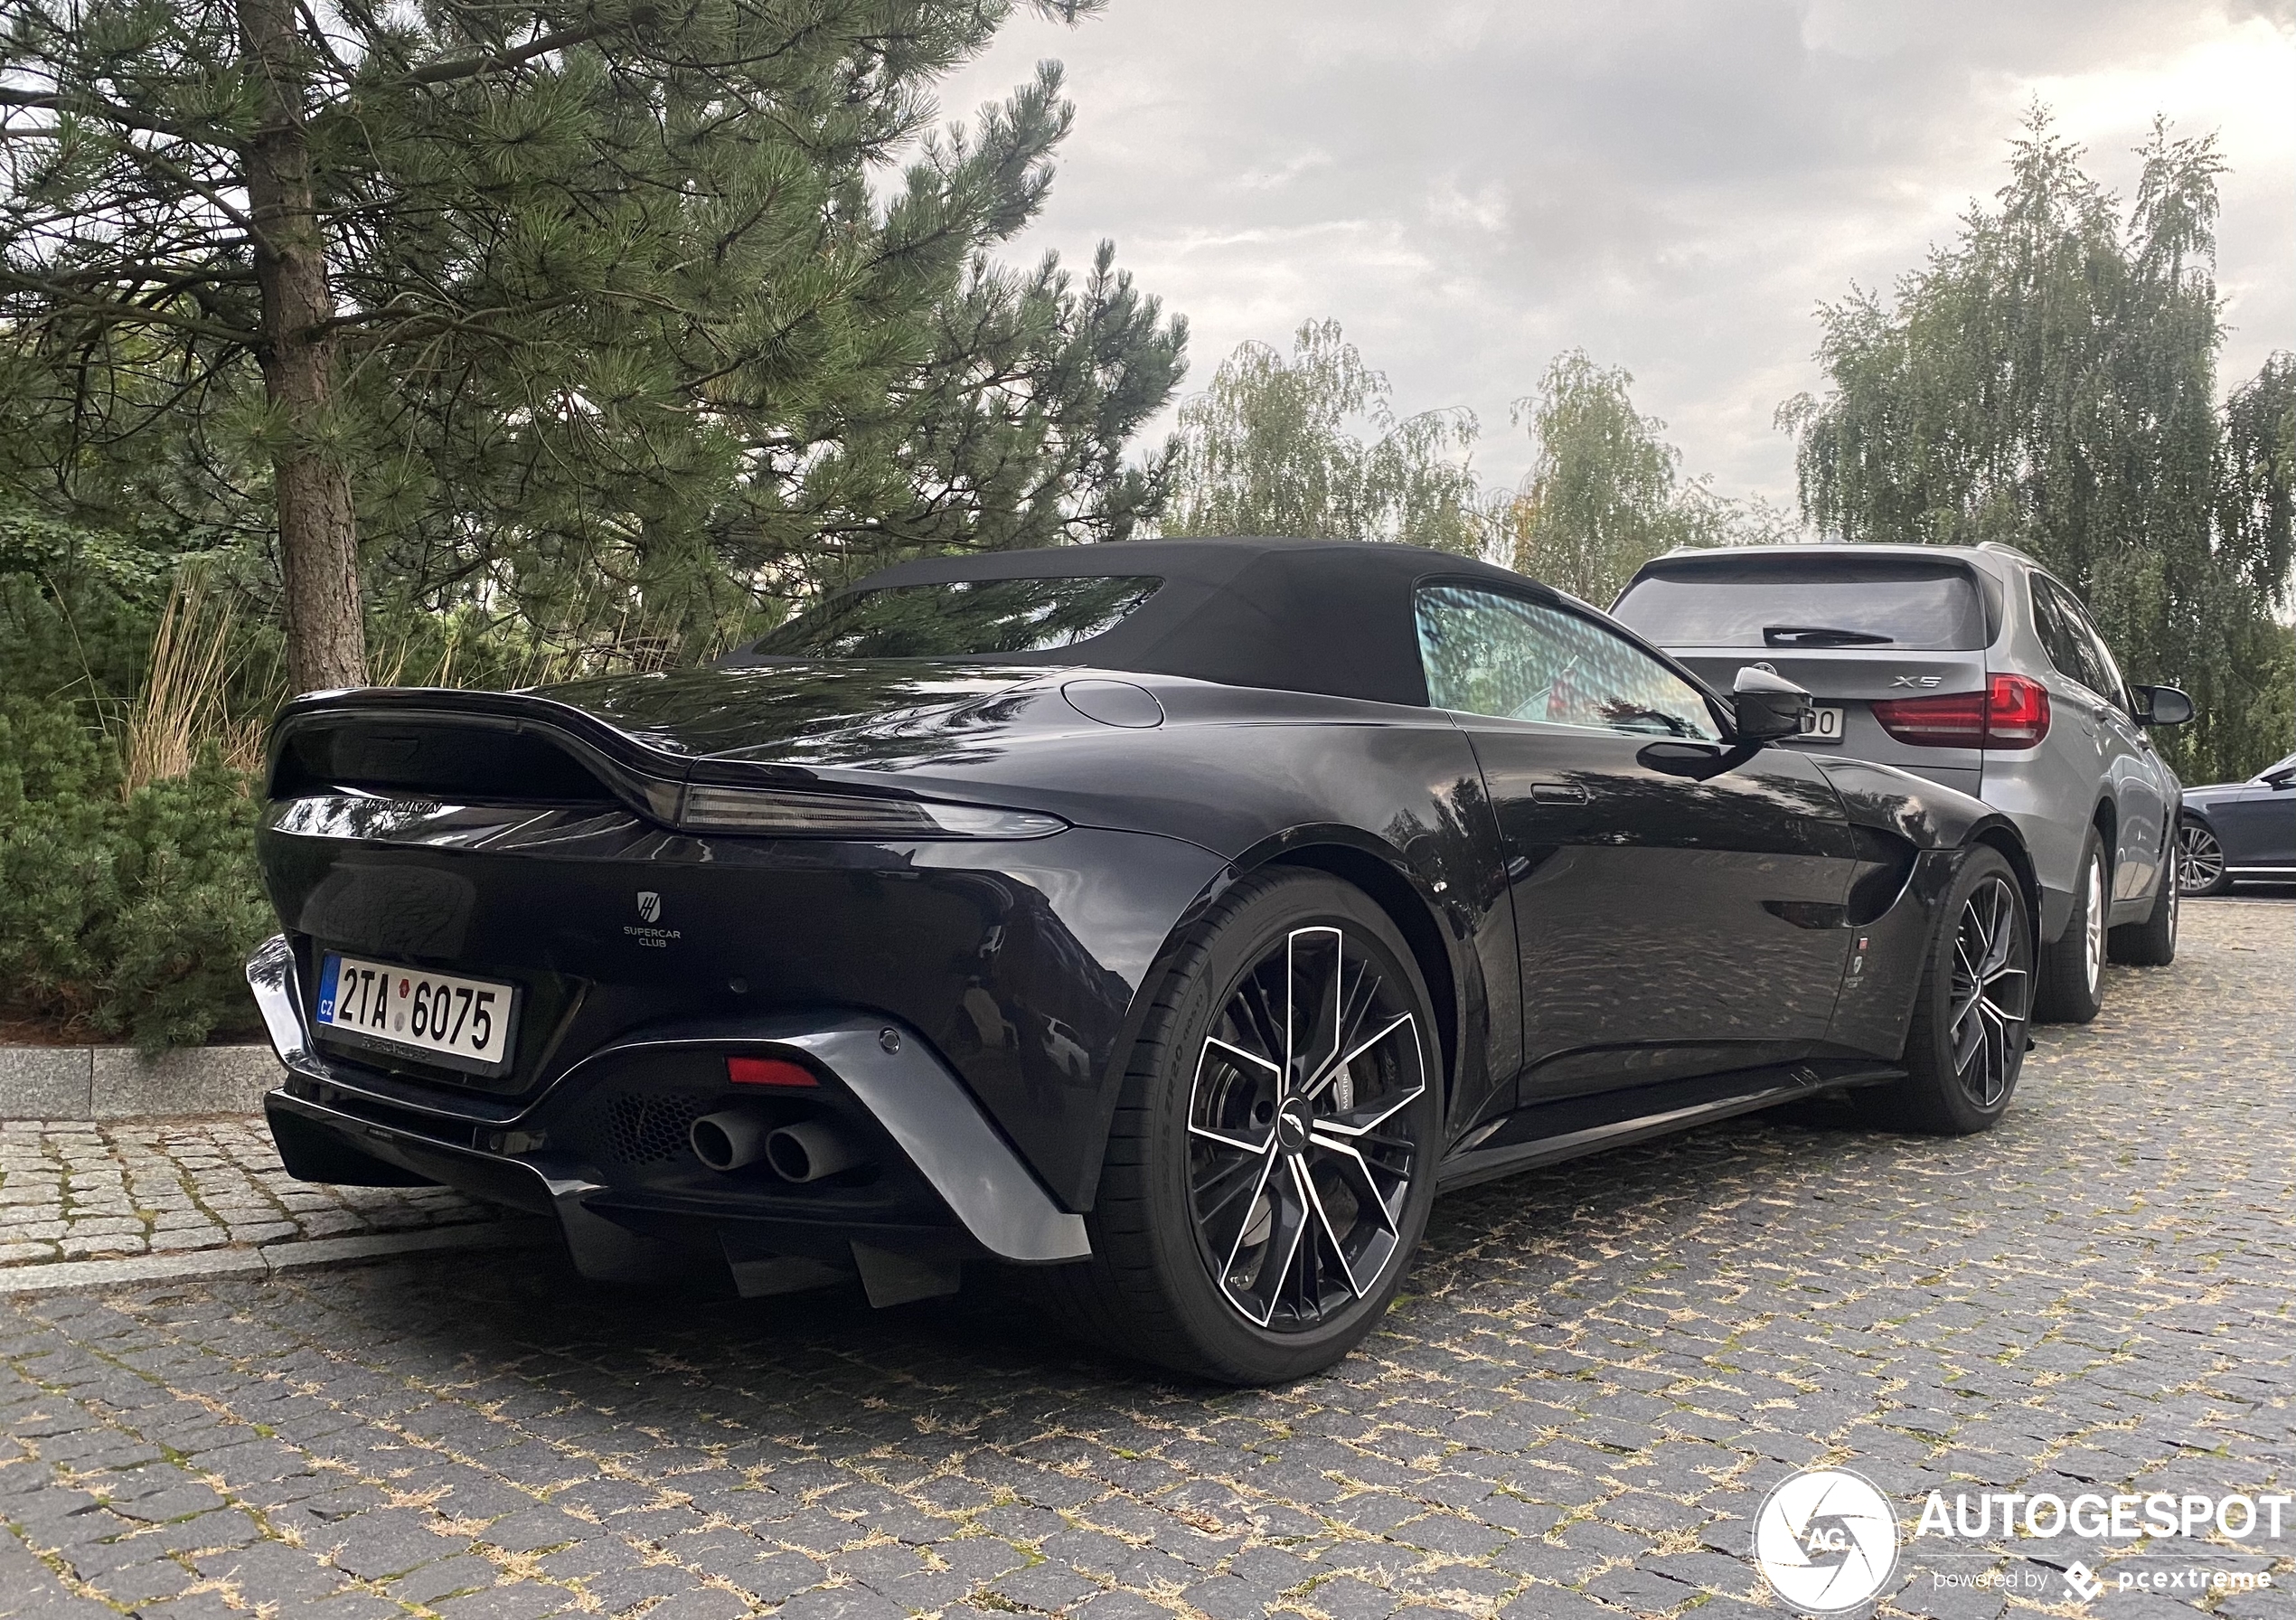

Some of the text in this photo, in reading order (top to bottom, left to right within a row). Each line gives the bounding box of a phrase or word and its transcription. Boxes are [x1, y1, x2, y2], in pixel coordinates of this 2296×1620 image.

[1887, 676, 1943, 688] X5
[623, 926, 681, 938] SUPERCAR
[638, 937, 666, 947] CLUB
[320, 999, 334, 1015] CZ
[339, 966, 496, 1050] 2TA 6075
